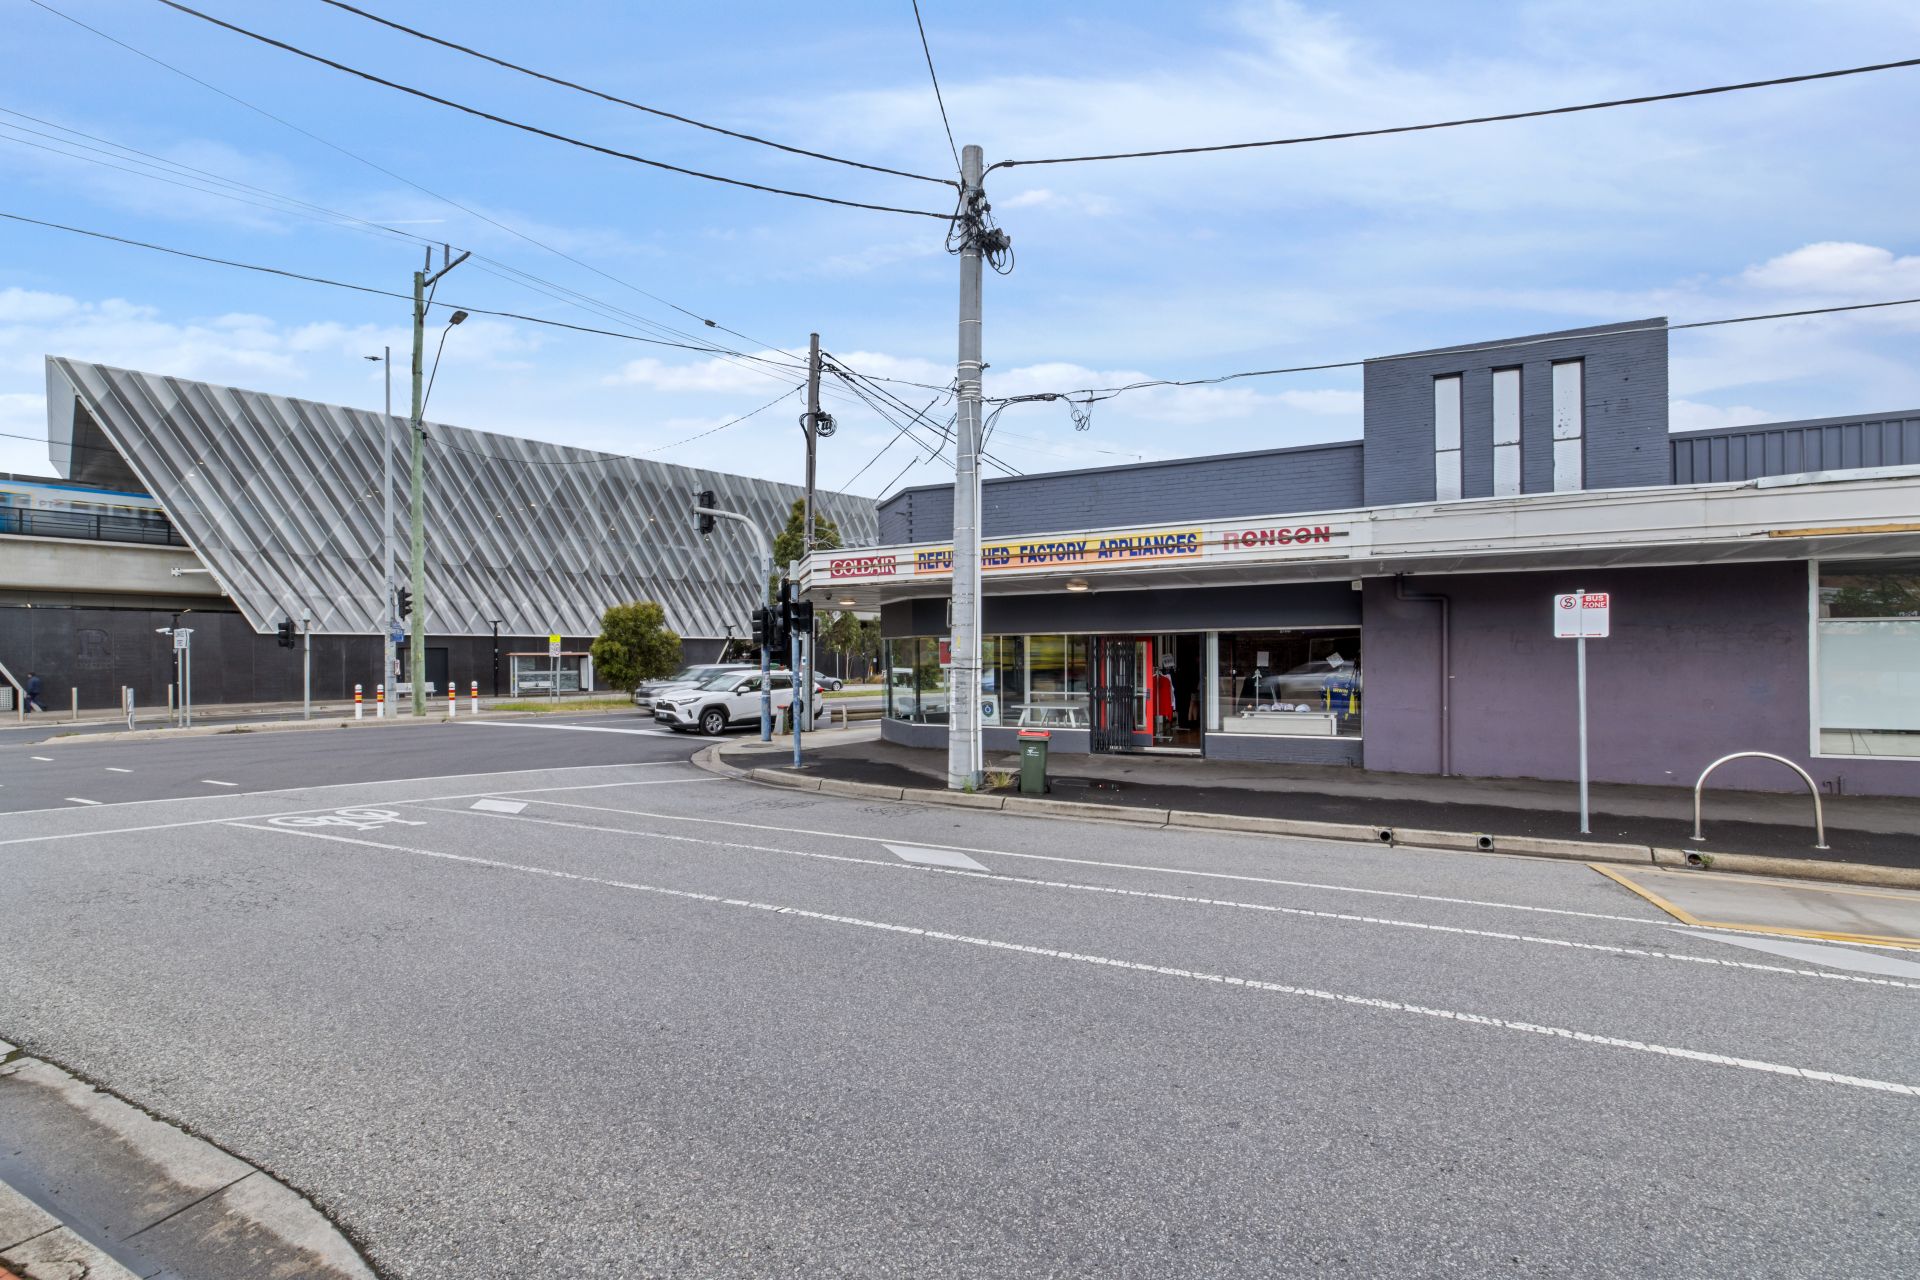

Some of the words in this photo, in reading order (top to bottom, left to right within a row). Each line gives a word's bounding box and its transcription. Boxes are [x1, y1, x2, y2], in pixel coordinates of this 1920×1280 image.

[918, 546, 1010, 570] REFUHED
[1020, 541, 1086, 563] FACTORY
[1098, 533, 1198, 558] APPLIANCES
[831, 557, 895, 576] GOLDAIR
